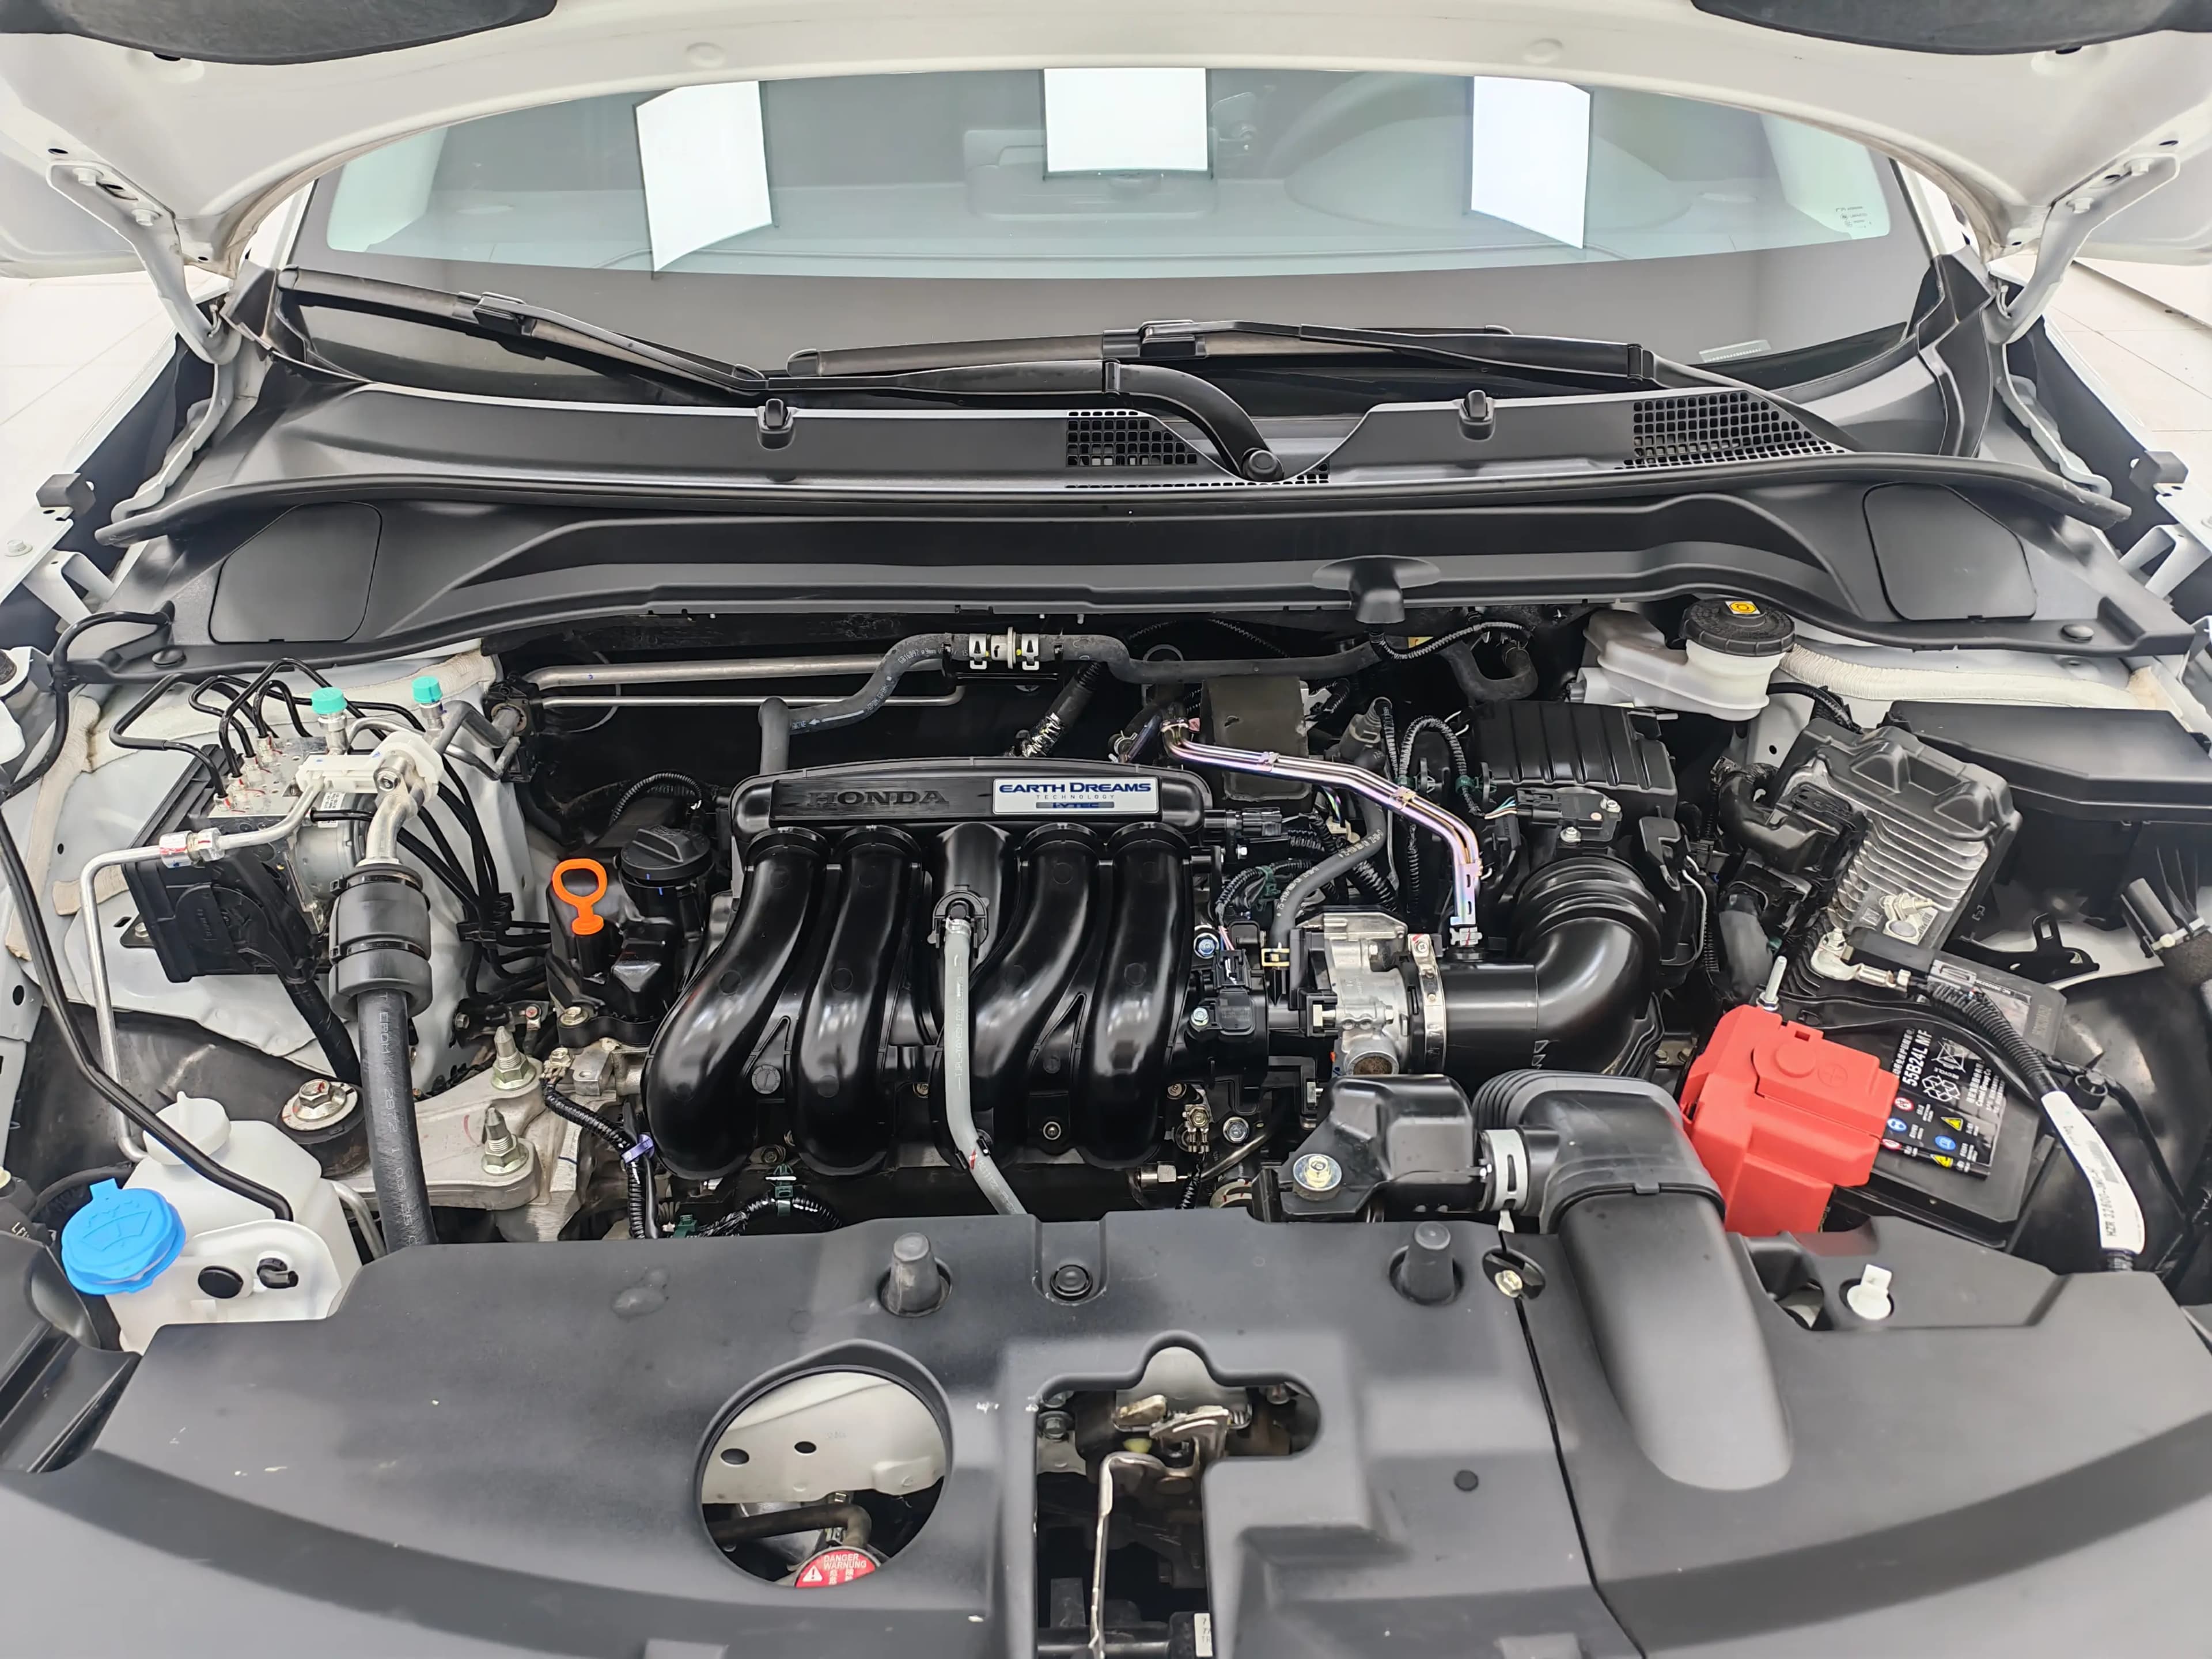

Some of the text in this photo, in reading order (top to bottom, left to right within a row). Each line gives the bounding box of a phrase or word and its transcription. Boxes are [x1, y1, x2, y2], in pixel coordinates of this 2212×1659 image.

[999, 782, 1151, 793] EARTH DREAMS
[806, 790, 949, 805] HONDA
[1915, 1029, 1933, 1047] MF
[1903, 1046, 1928, 1087] 55B24L
[824, 1553, 859, 1562] DANGER
[824, 1560, 867, 1571] WARNUNG
